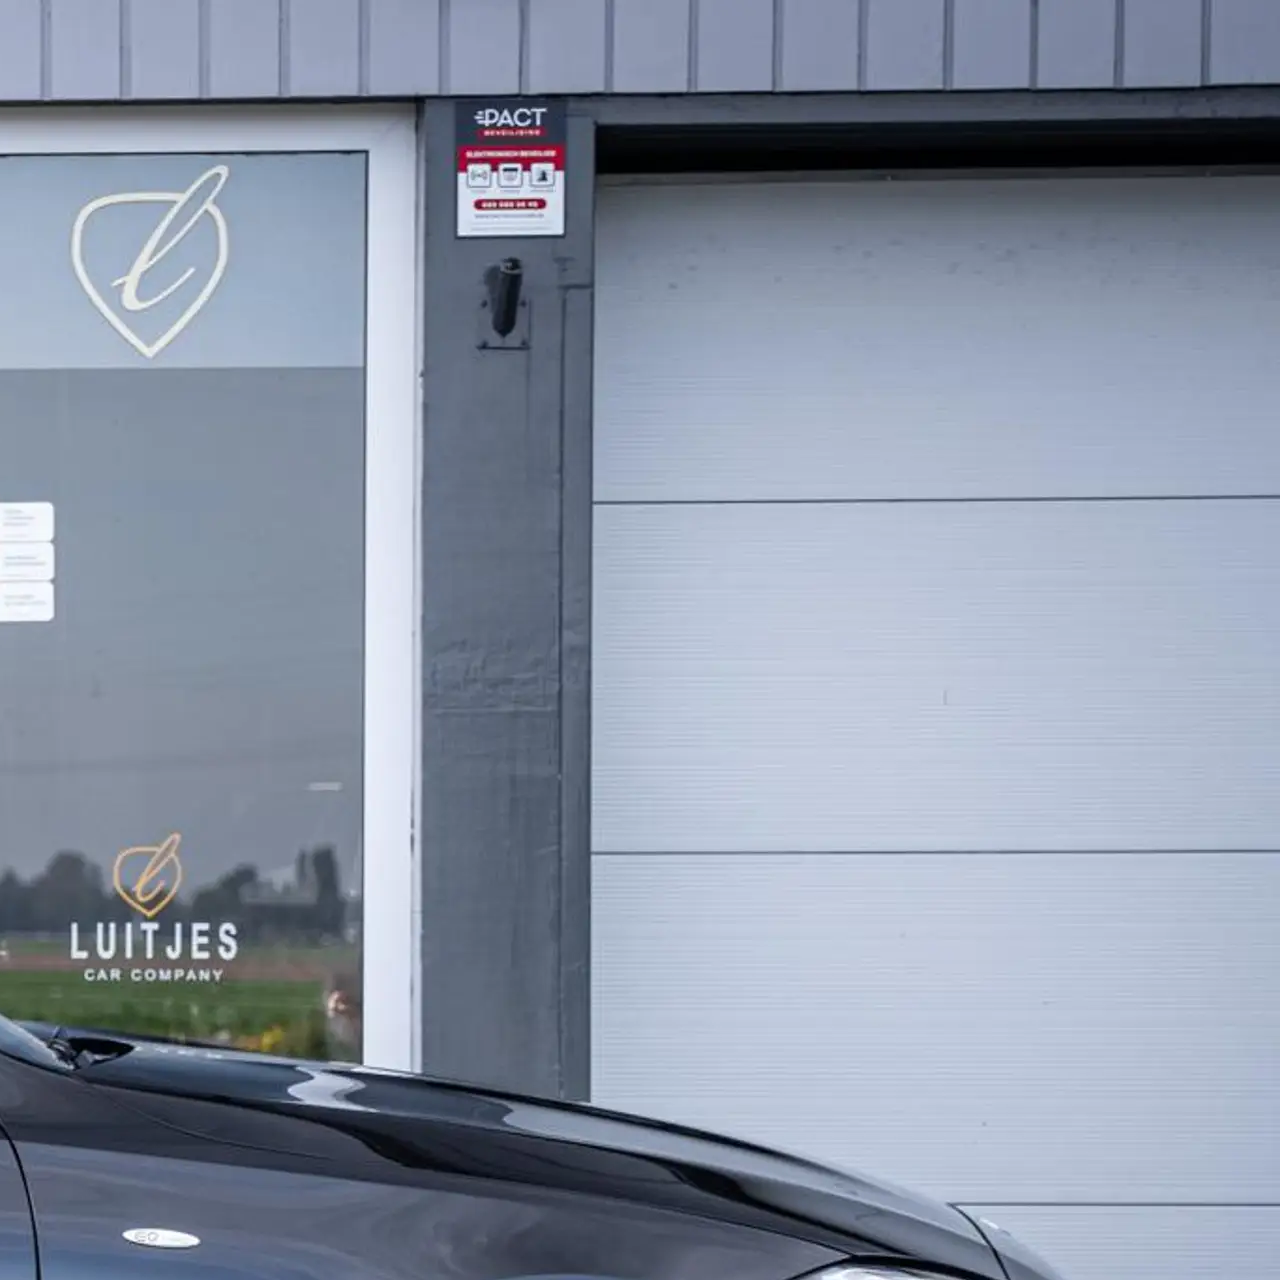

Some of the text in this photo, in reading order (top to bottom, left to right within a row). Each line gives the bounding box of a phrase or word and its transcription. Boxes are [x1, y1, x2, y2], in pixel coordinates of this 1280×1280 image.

[482, 108, 547, 127] PACT
[70, 922, 239, 960] LUITJES
[84, 968, 224, 982] CAR COMPANY
